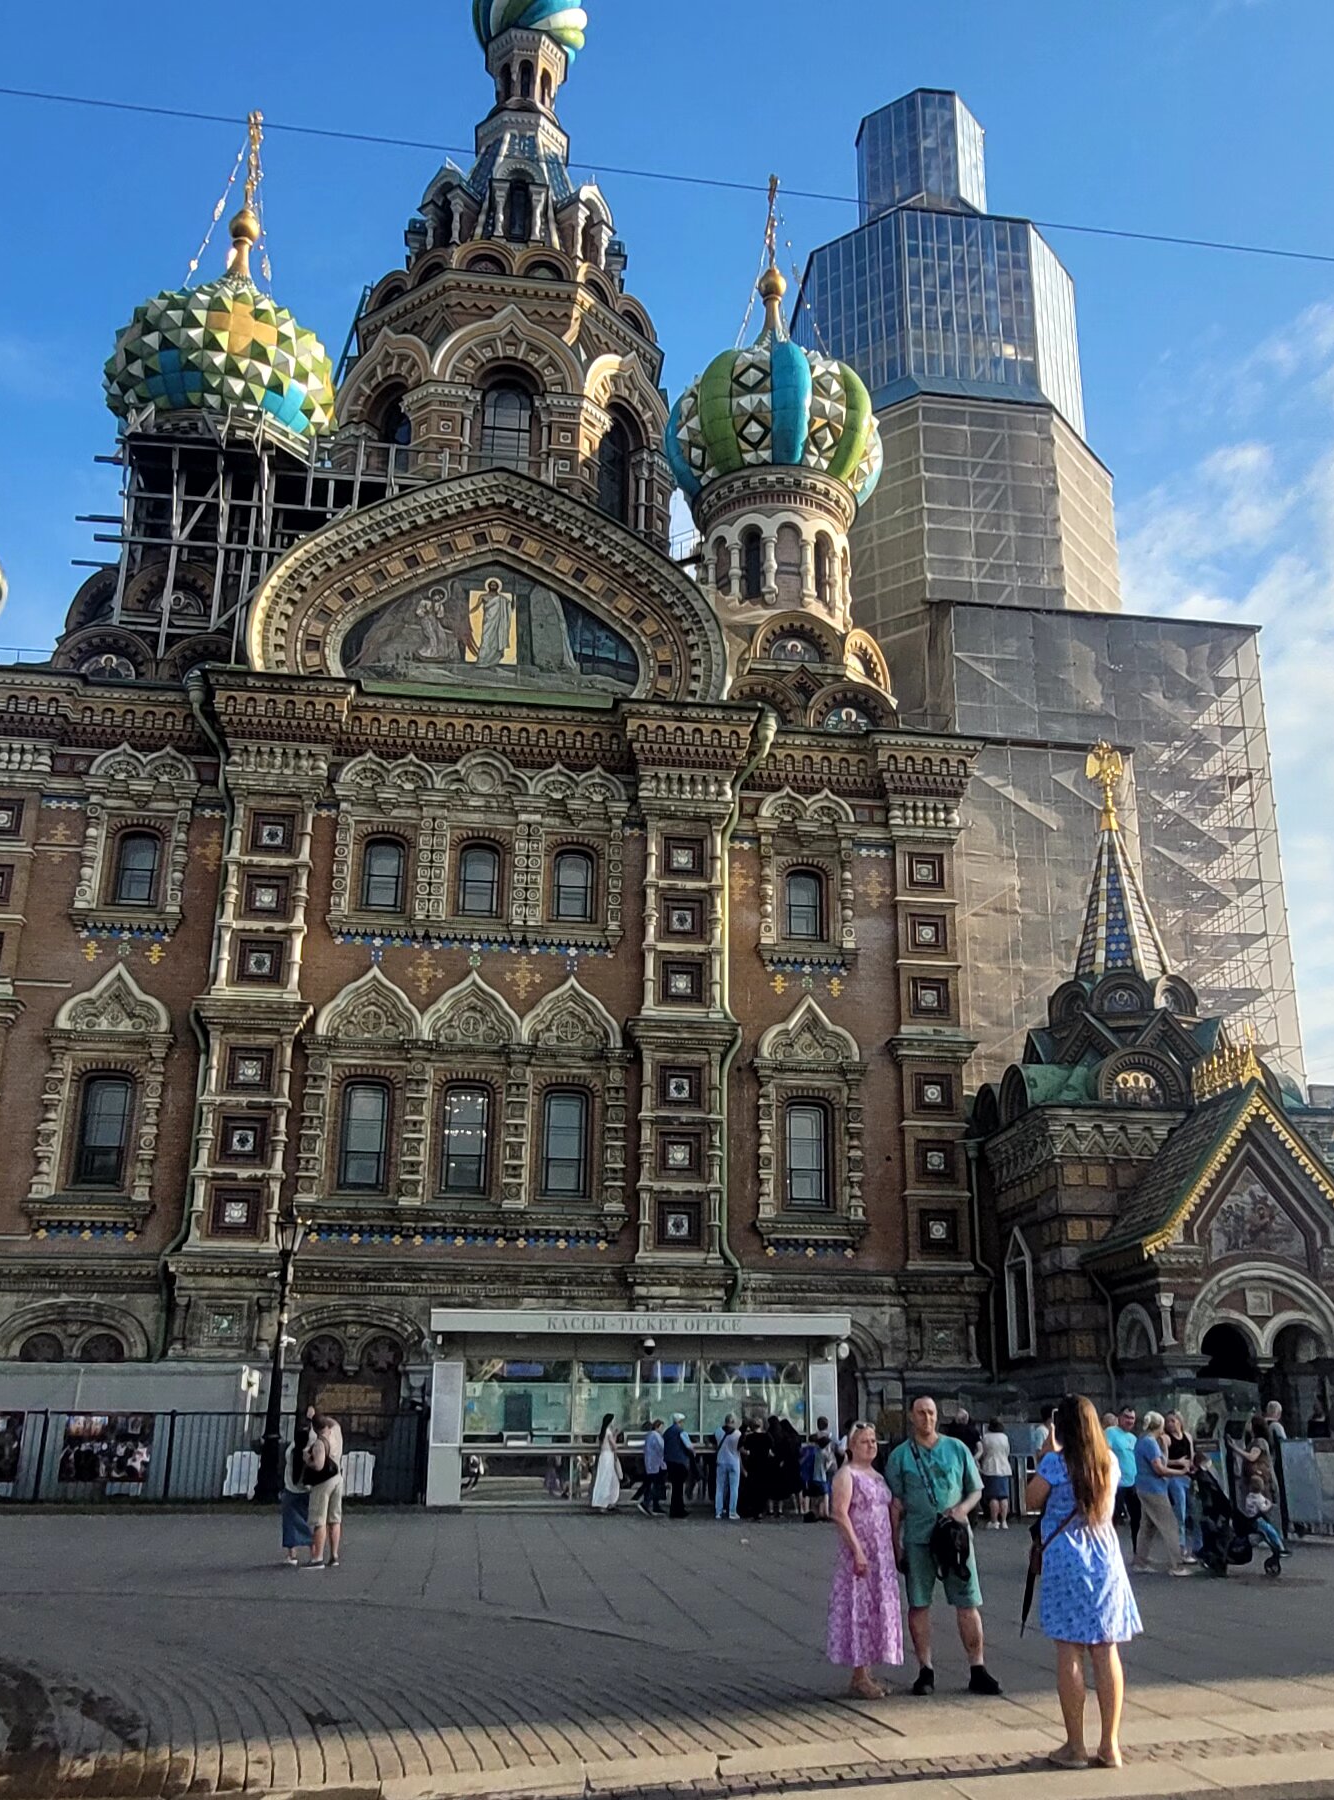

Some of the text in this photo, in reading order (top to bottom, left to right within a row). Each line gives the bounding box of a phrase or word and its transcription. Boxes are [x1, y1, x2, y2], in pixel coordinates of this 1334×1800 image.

[547, 1316, 742, 1332] КАССЫ TICKET OFFICE
